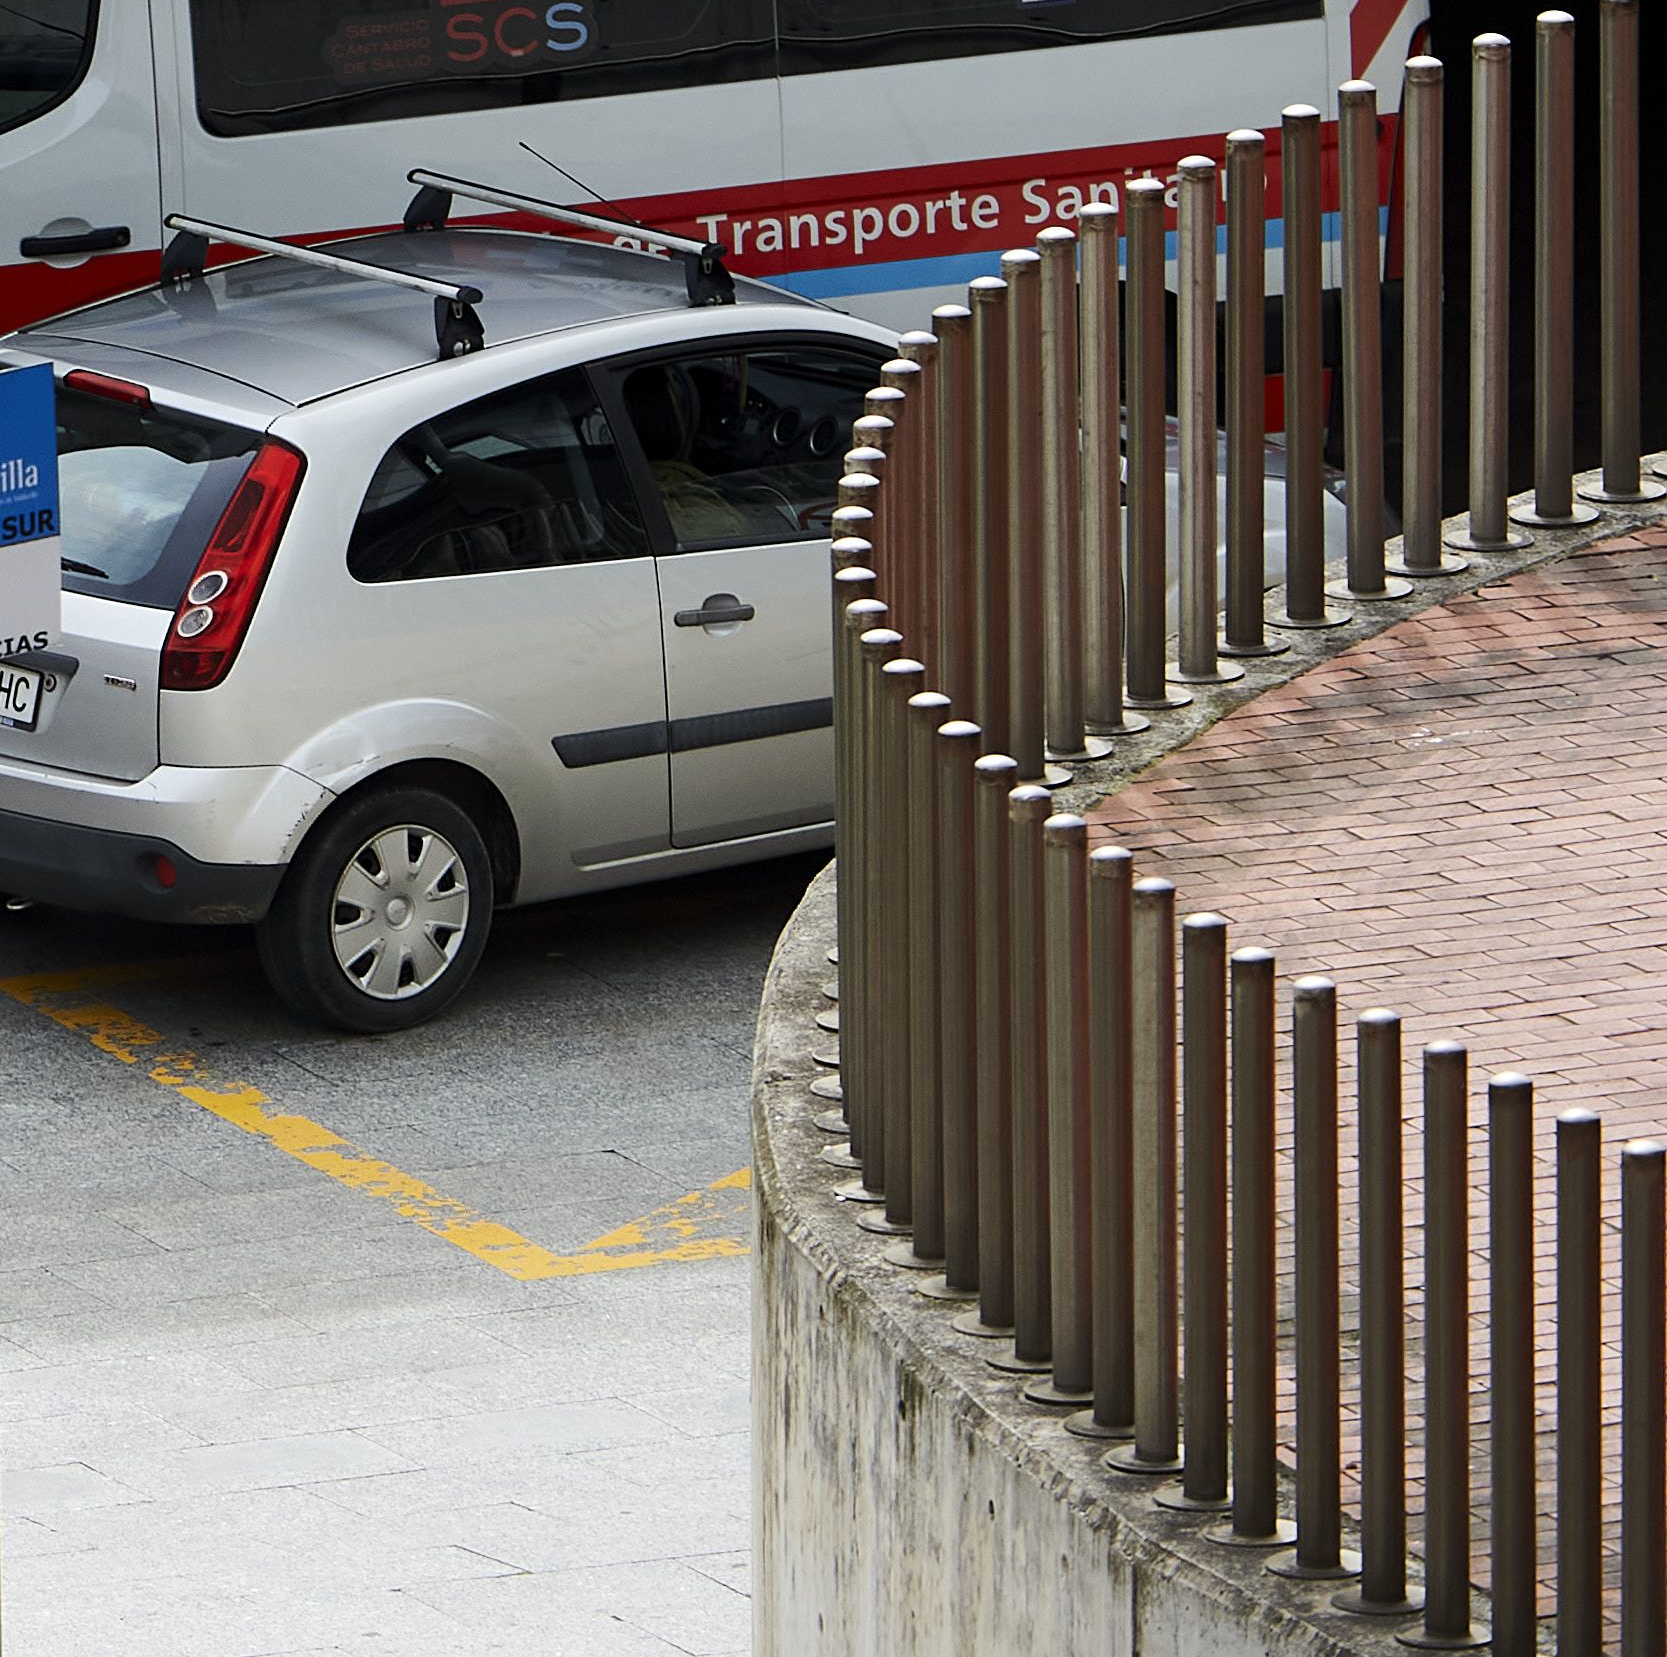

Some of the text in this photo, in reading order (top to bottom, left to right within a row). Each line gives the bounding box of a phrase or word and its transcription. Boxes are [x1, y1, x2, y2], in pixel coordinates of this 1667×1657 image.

[347, 18, 428, 38] SERVICIO
[445, 1, 588, 62] SCS
[331, 37, 431, 58] CANTABRO
[344, 55, 431, 75] DE SALUD
[695, 194, 1001, 256] Transporte
[2, 508, 55, 541] SUR
